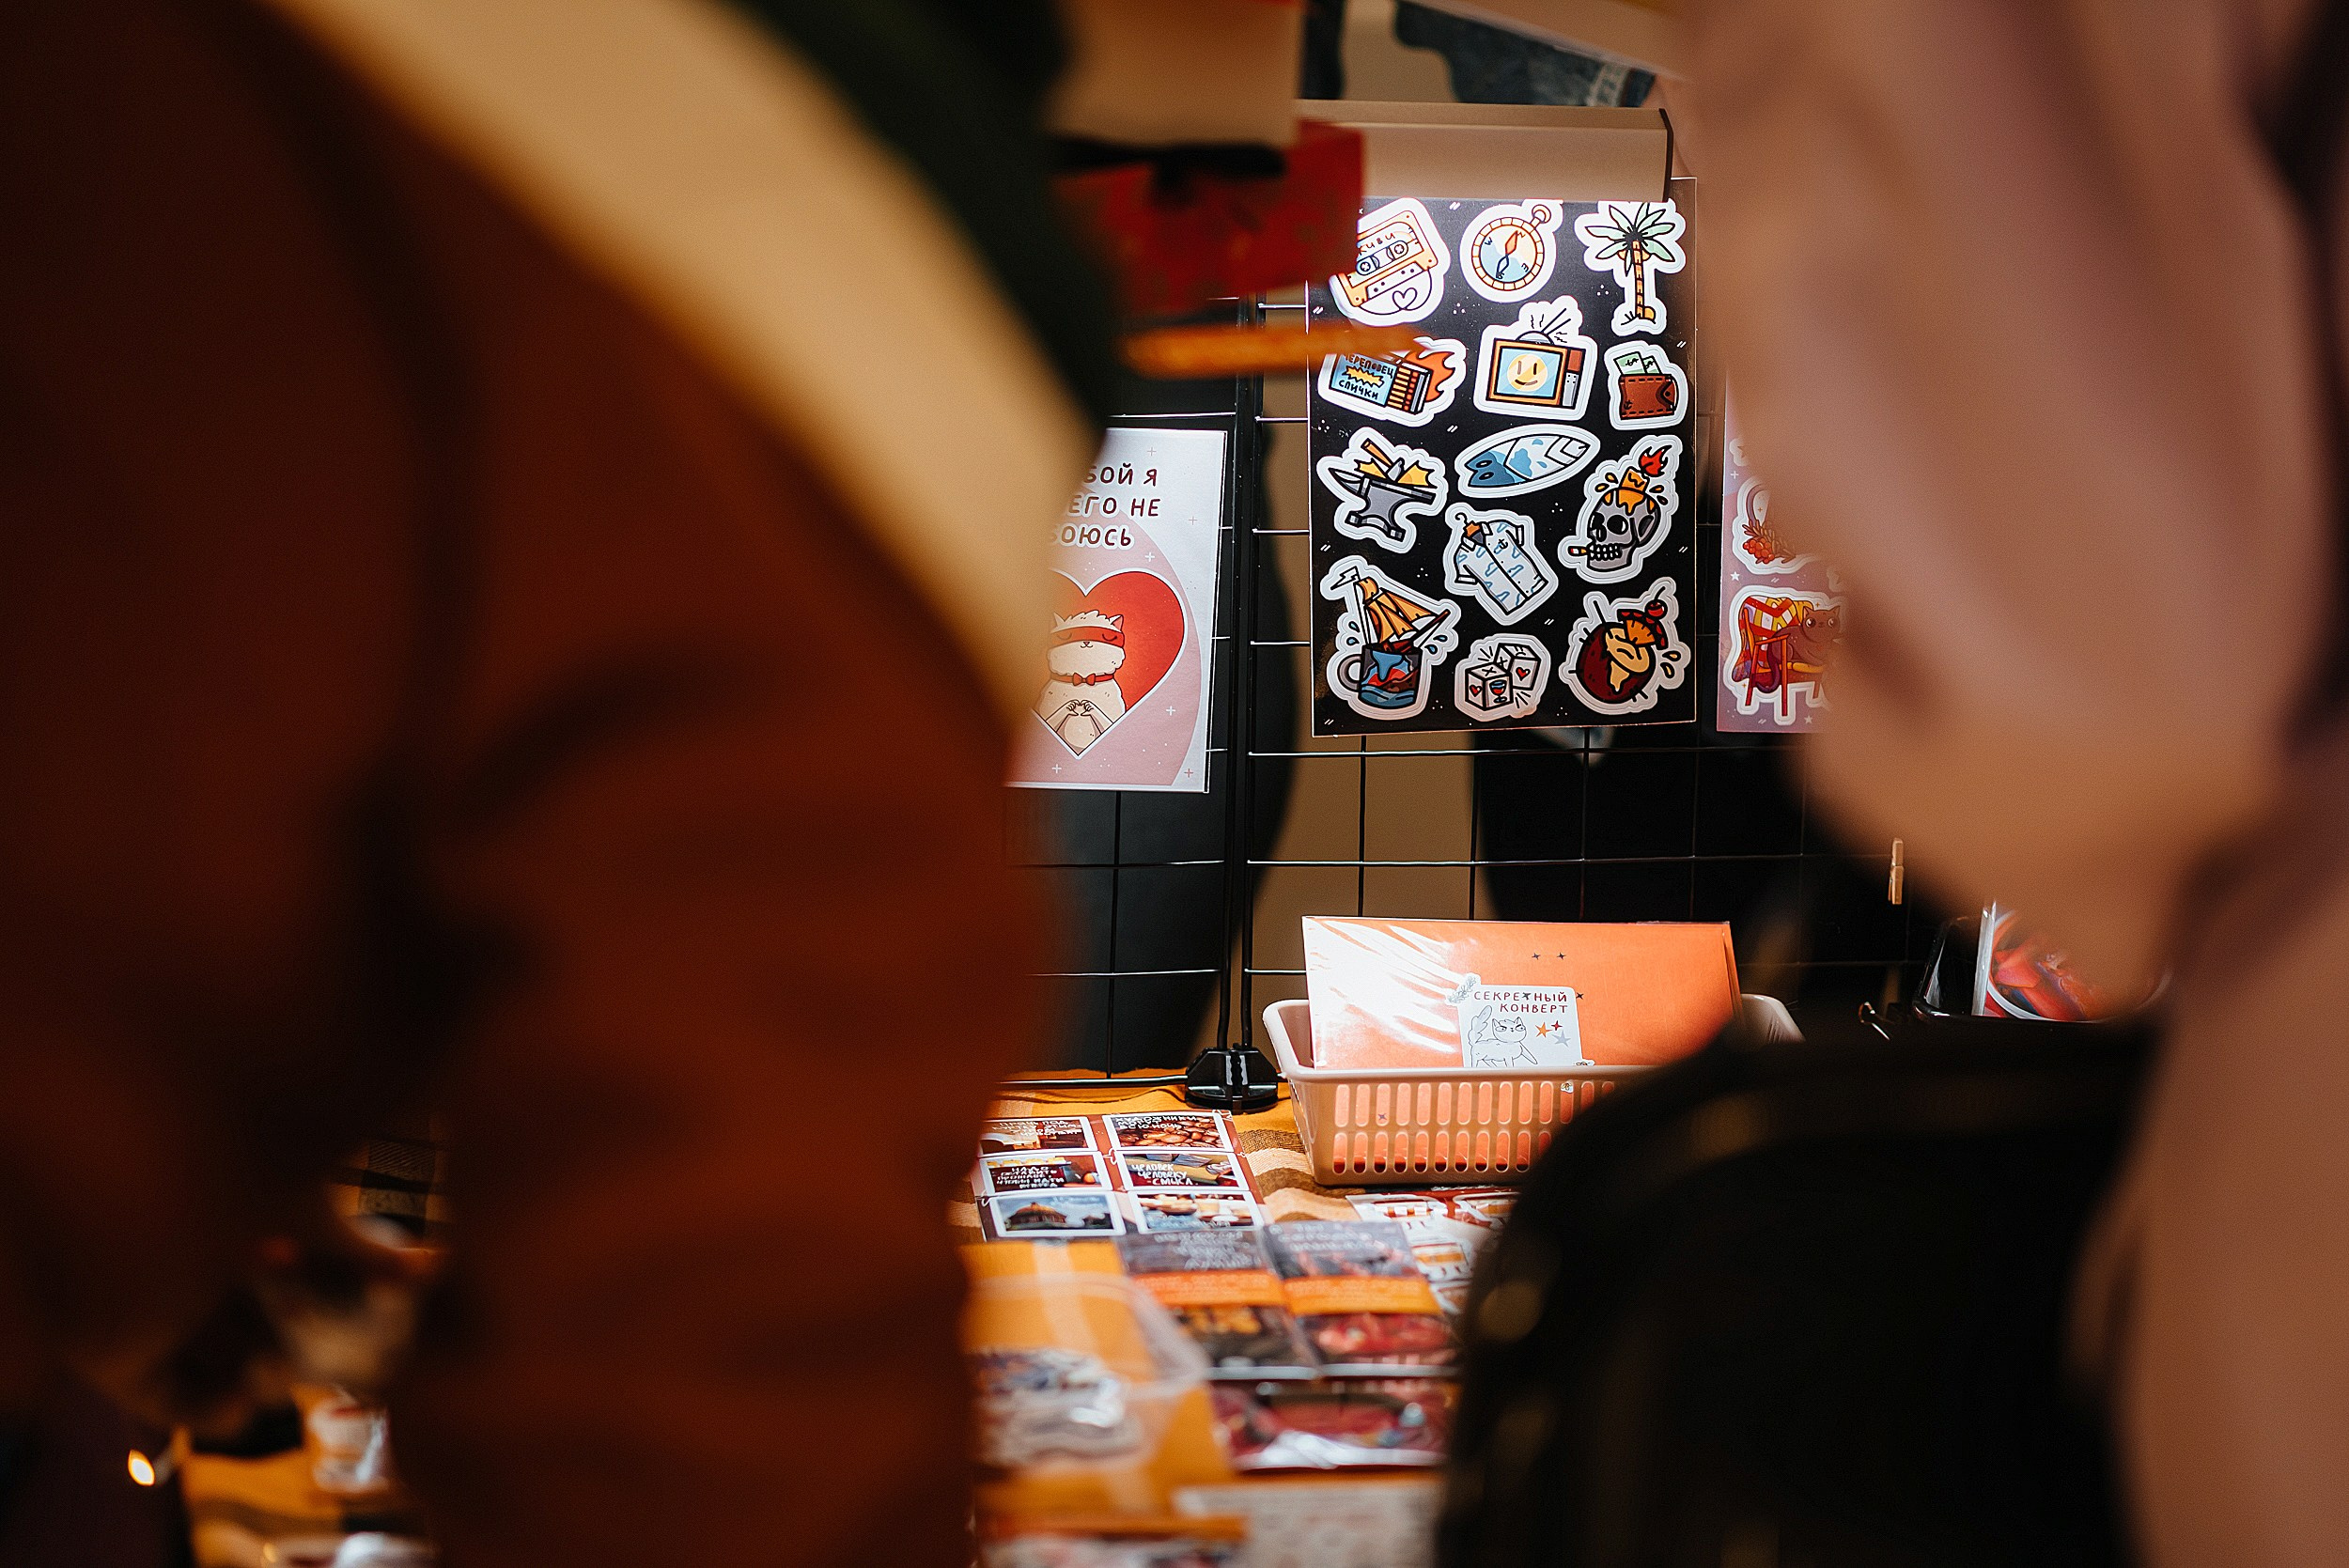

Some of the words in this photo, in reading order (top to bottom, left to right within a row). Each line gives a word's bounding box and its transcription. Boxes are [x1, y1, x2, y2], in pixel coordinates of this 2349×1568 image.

[1338, 380, 1379, 400] СПИЧКИ
[1143, 468, 1158, 487] Я
[1130, 498, 1161, 517] НЕ
[1500, 1003, 1568, 1014] КОНВЕРТ
